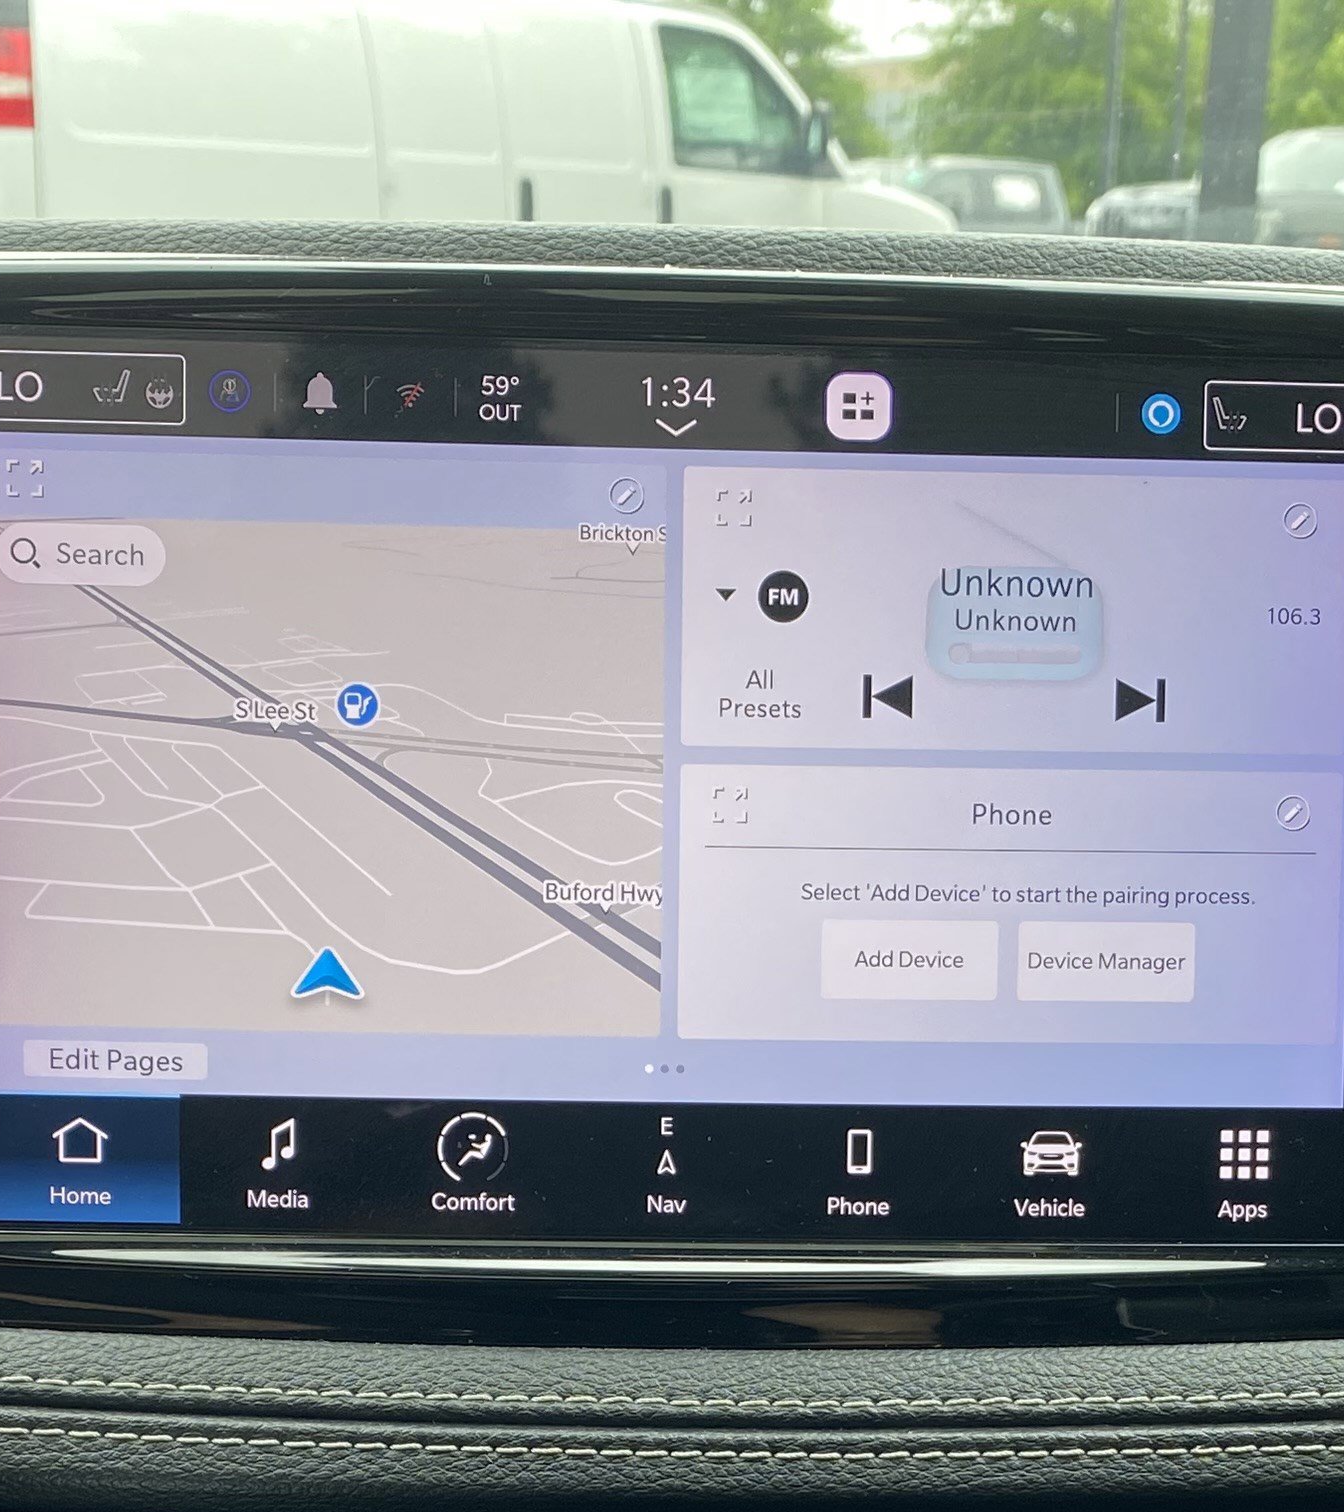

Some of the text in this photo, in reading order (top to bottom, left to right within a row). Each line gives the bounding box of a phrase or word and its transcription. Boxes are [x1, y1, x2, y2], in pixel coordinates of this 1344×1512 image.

[480, 375, 520, 396] 59°
[641, 375, 716, 408] 1:34
[478, 403, 521, 422] OUT
[1295, 402, 1342, 434] LO
[579, 524, 654, 542] Brickton
[56, 542, 145, 568] Search
[940, 567, 1094, 599] Unknown
[767, 586, 799, 605] FM
[954, 609, 1077, 633] Unknown
[1267, 607, 1321, 626] 106.3
[746, 669, 774, 690] All
[236, 701, 316, 720] S Lee St
[718, 699, 802, 719] Presets
[972, 803, 1053, 826] Phone
[545, 882, 662, 906] Buford Hwy
[801, 883, 1256, 910] Select 'Add Device' to start the pairing process.
[855, 950, 964, 969] Add Device
[1028, 952, 1186, 976] Device Manager
[49, 1049, 183, 1076] Edit Pages
[660, 1117, 673, 1134] E
[49, 1186, 112, 1206] Home
[247, 1189, 309, 1209] Media
[431, 1191, 515, 1213] Comfort
[647, 1196, 686, 1214] Nav
[827, 1198, 890, 1217] Phone
[1014, 1199, 1085, 1218] Vehicle
[1218, 1200, 1267, 1222] Apps
